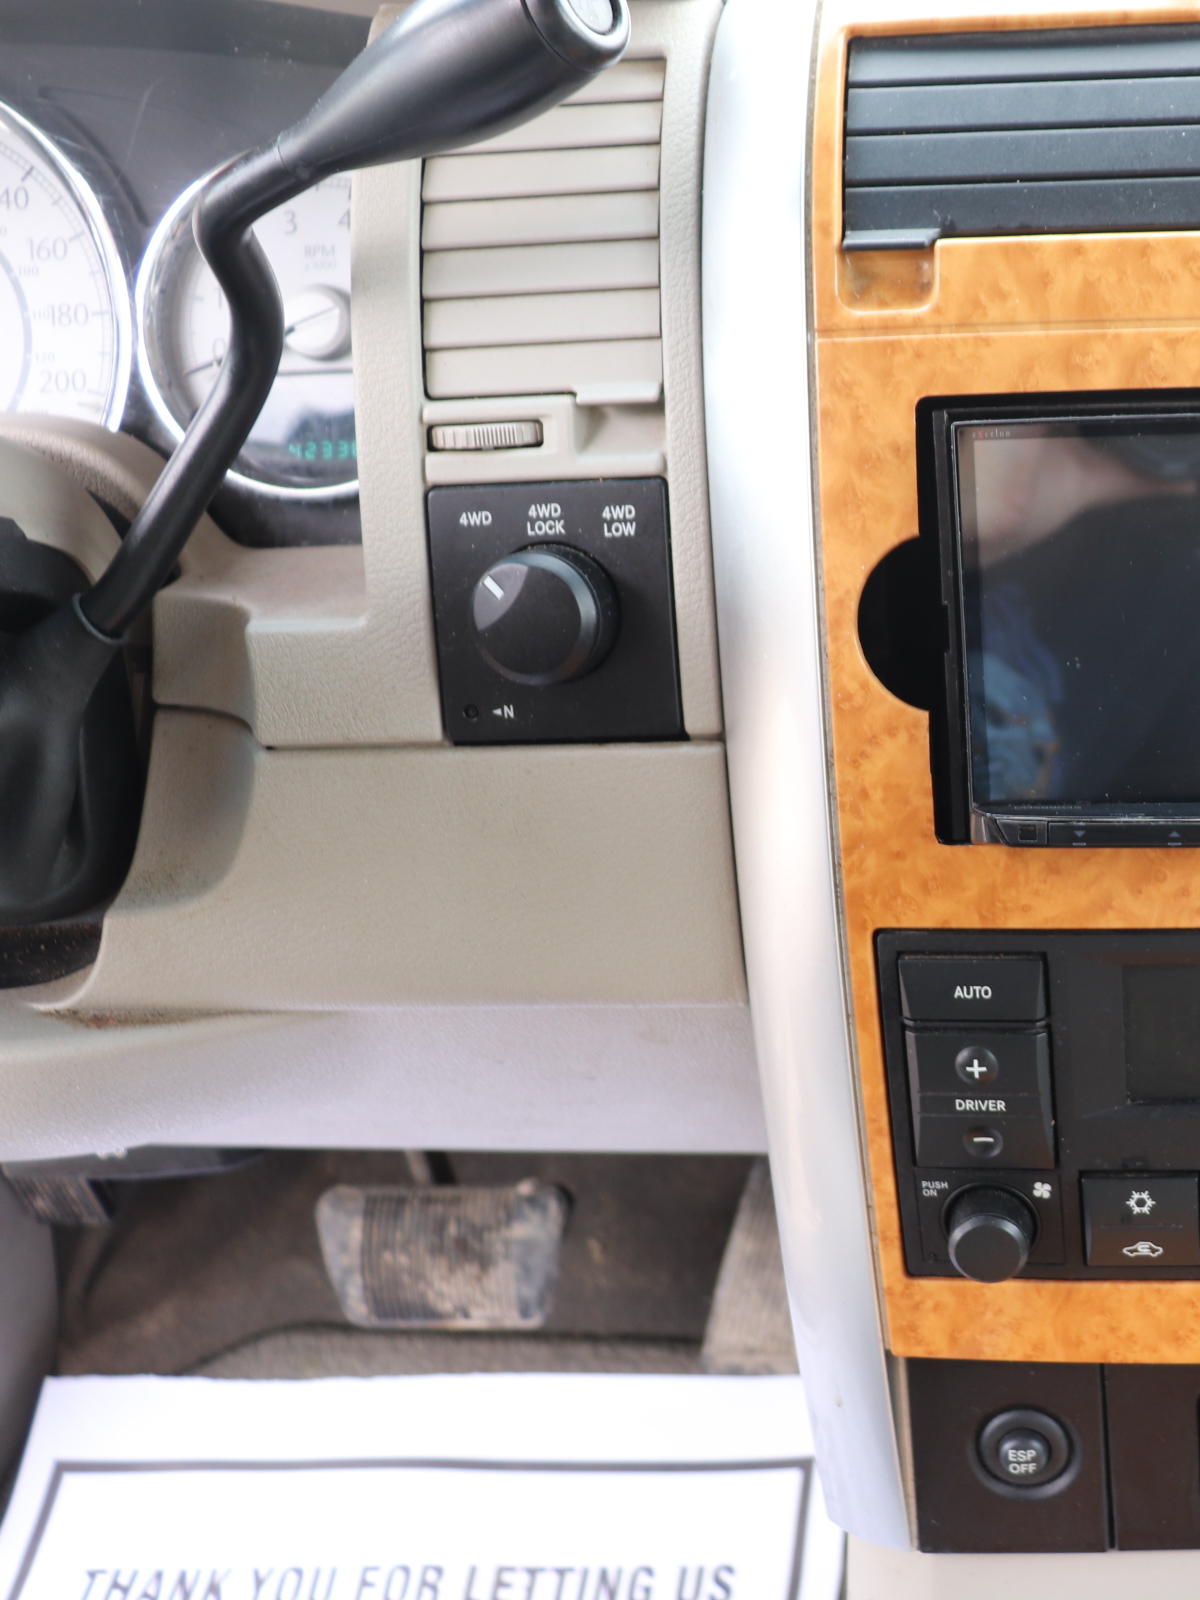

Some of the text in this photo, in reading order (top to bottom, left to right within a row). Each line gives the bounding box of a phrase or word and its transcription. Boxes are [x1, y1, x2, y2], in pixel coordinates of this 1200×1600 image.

[284, 209, 298, 235] 3
[337, 207, 351, 232] 4
[27, 236, 69, 262] 160
[303, 244, 336, 258] RPM
[18, 265, 39, 276] 100
[51, 302, 90, 327] 180
[39, 368, 87, 394] 200
[528, 503, 561, 518] 4WD
[602, 505, 636, 520] 4WD
[459, 511, 492, 526] 4WD
[527, 520, 565, 536] LOCK
[604, 522, 636, 537] LOW
[503, 705, 515, 719] N
[954, 985, 992, 999] AUTO
[955, 1099, 1007, 1112] DRIVER
[922, 1180, 948, 1189] PUSH
[923, 1189, 938, 1197] ON
[1008, 1449, 1037, 1461] ESP
[1009, 1463, 1037, 1474] OFF
[81, 1564, 736, 1600] THANK YOU FOR LETTING US
